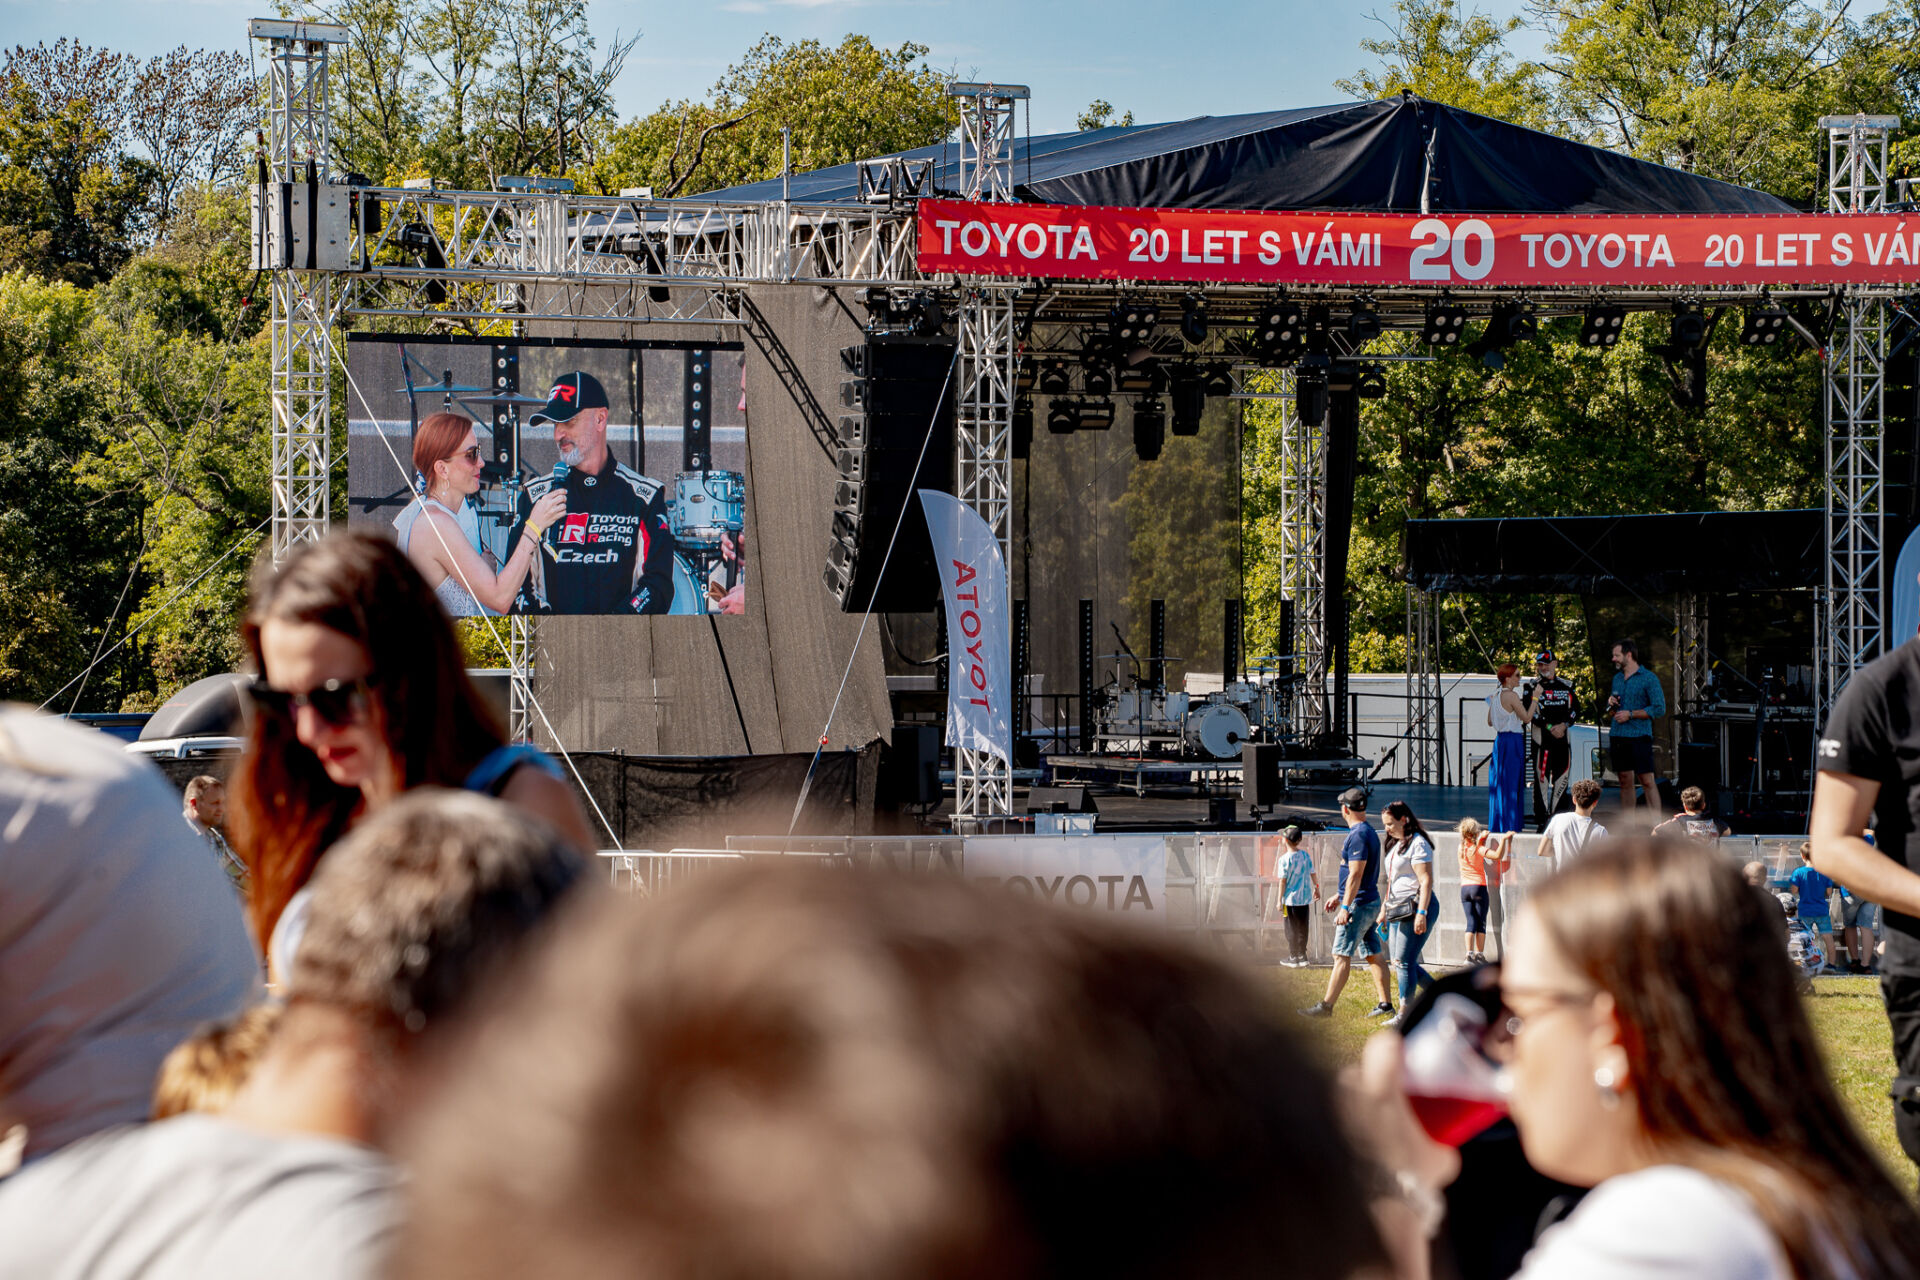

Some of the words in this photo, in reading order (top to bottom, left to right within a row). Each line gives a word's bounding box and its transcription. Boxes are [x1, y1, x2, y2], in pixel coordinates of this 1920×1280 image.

[936, 219, 1098, 260] TOYOTA
[1128, 228, 1170, 263] 20
[1181, 229, 1248, 264] LET
[1257, 230, 1282, 265] S
[1291, 222, 1381, 267] VÁMI
[1409, 218, 1495, 281] 20
[1520, 233, 1676, 269] TOYOTA
[1704, 233, 1745, 267] 20
[1755, 233, 1821, 267] LET
[1830, 232, 1854, 267] S
[590, 514, 639, 525] TOYOTA
[587, 533, 632, 547] Racing
[556, 549, 619, 564] Czech
